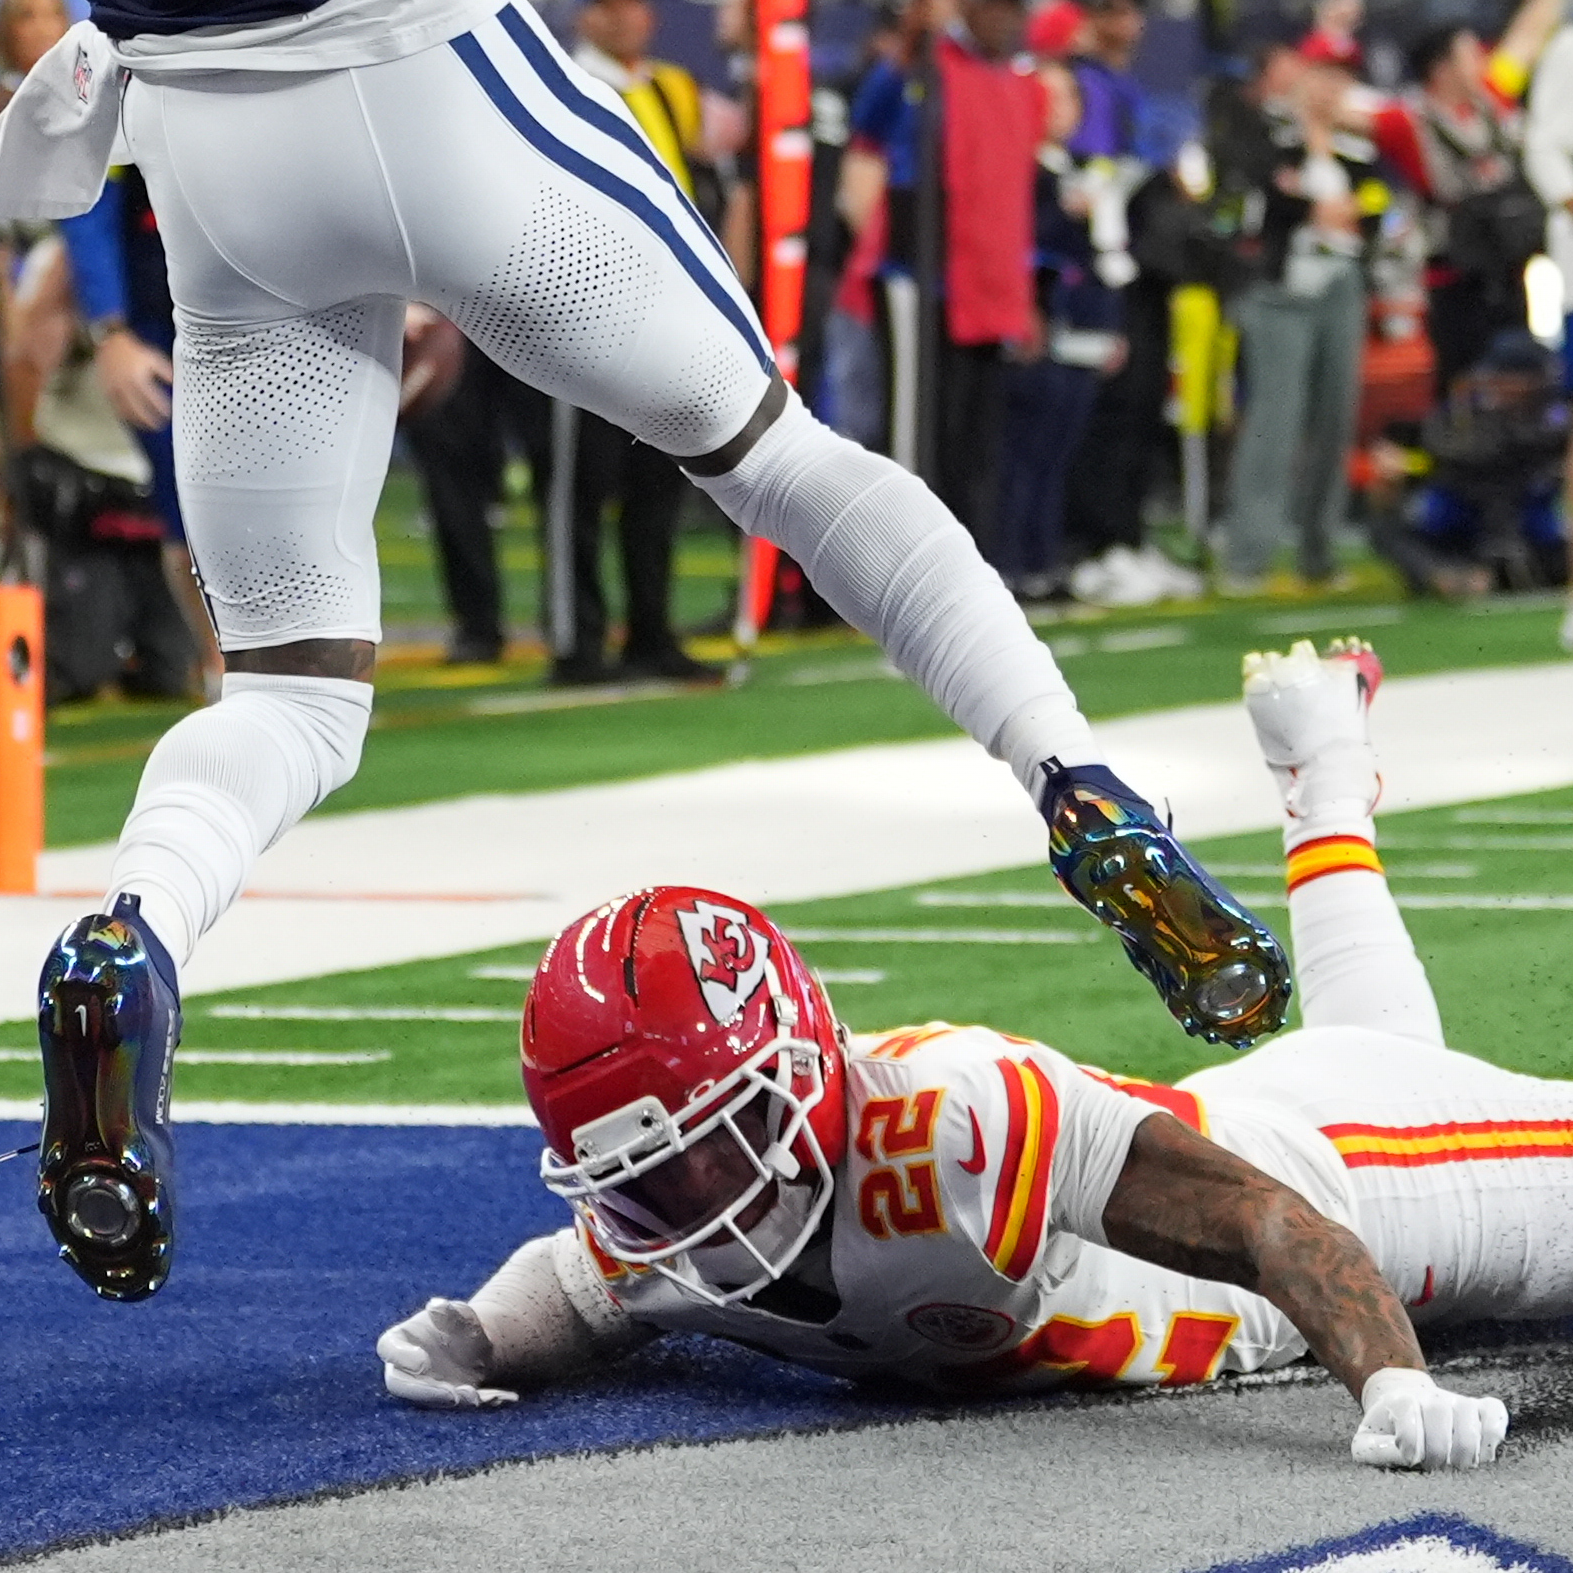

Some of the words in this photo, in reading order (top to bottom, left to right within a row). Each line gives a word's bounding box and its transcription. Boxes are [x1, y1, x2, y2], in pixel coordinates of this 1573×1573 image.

[699, 914, 755, 993] KC
[154, 1076, 168, 1125] ZOOM
[855, 1086, 949, 1241] 22
